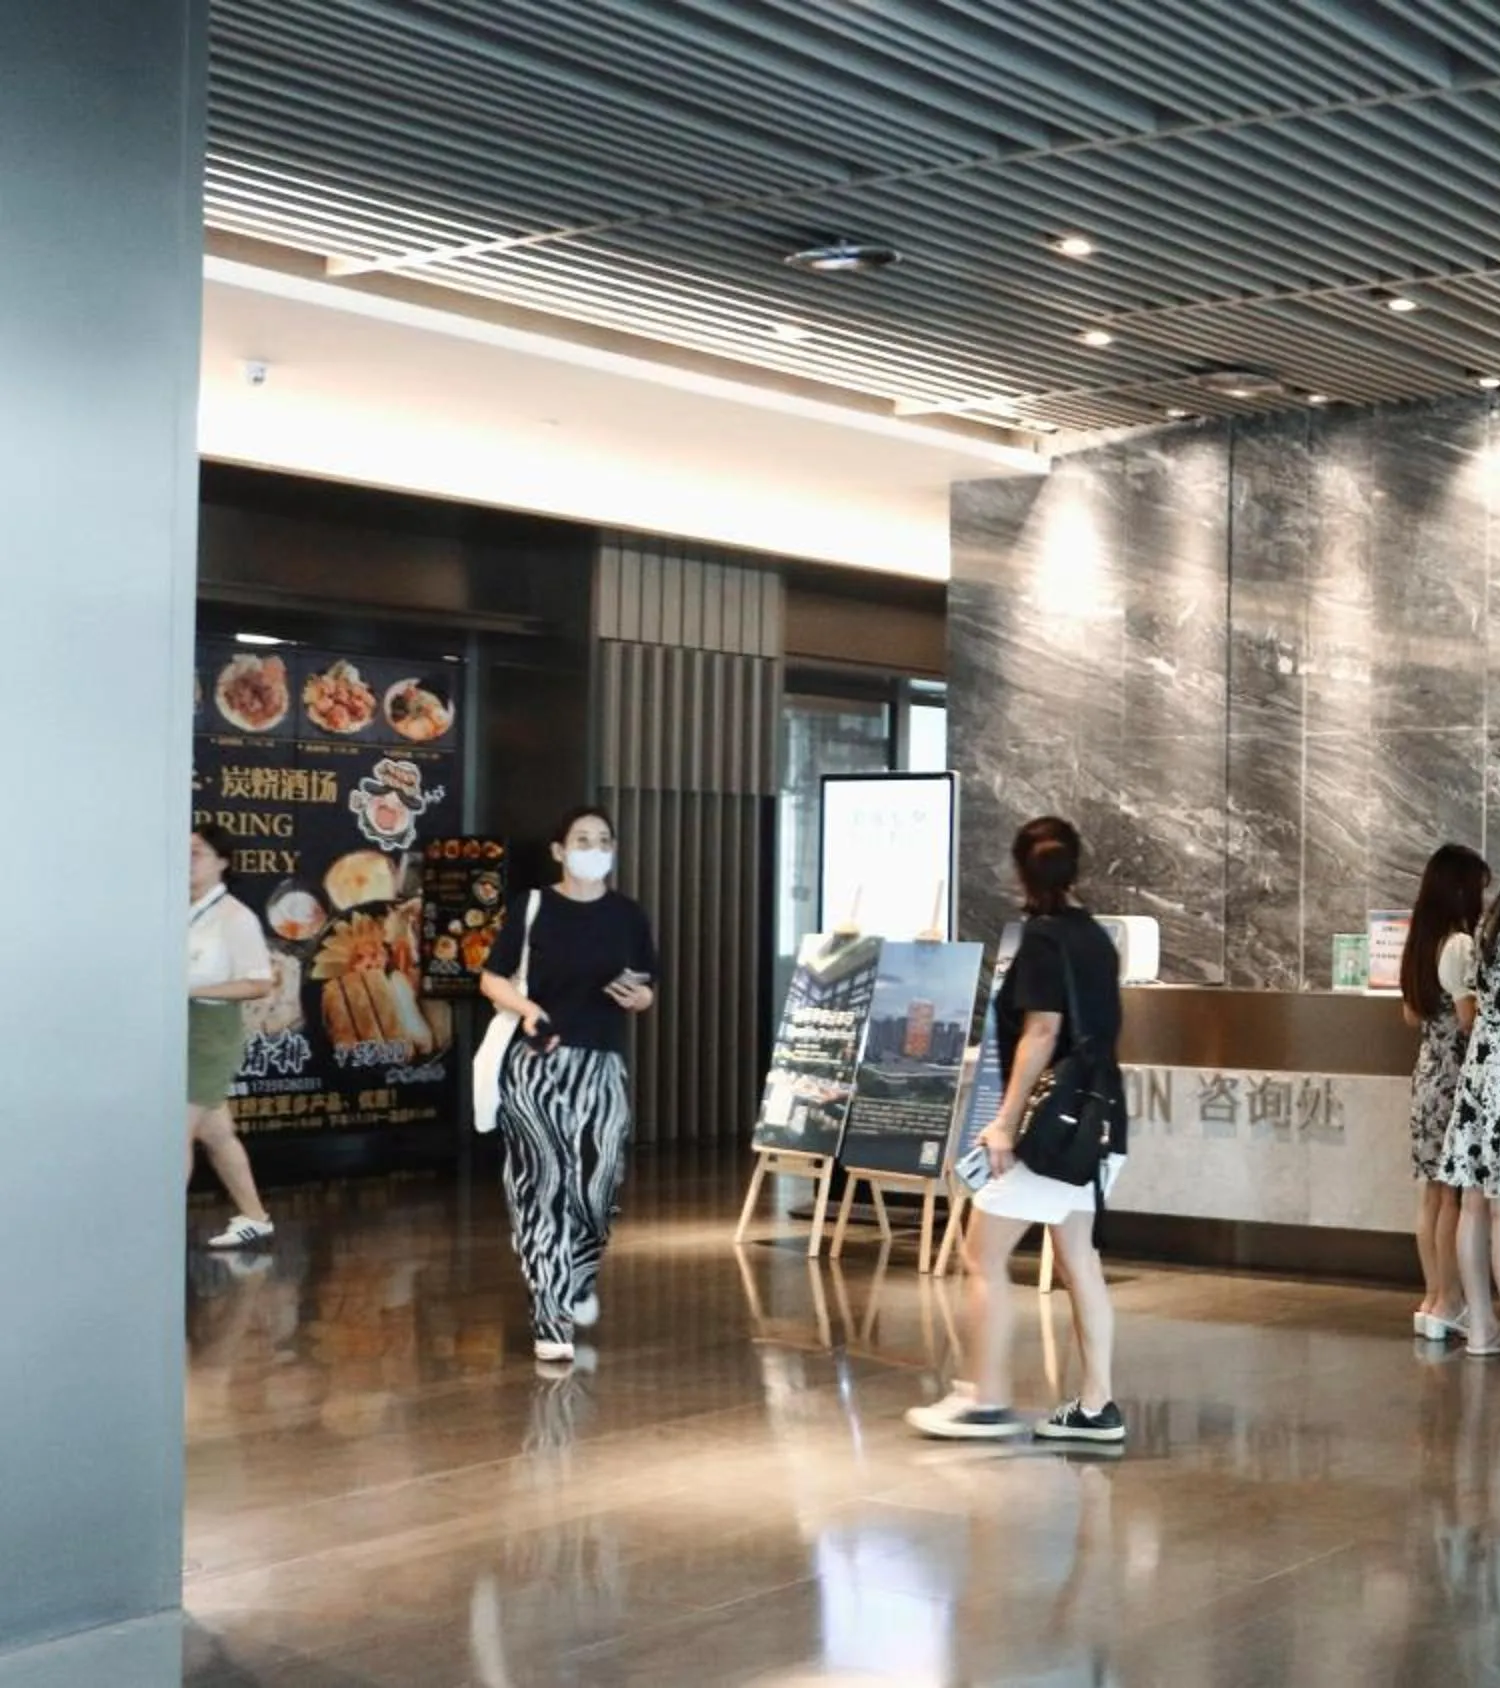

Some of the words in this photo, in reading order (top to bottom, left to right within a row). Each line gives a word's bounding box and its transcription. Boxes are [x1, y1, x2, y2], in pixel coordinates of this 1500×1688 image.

[220, 765, 338, 803] 炭烧酒场
[232, 849, 301, 874] ERY
[1198, 1073, 1345, 1131] 咨询处
